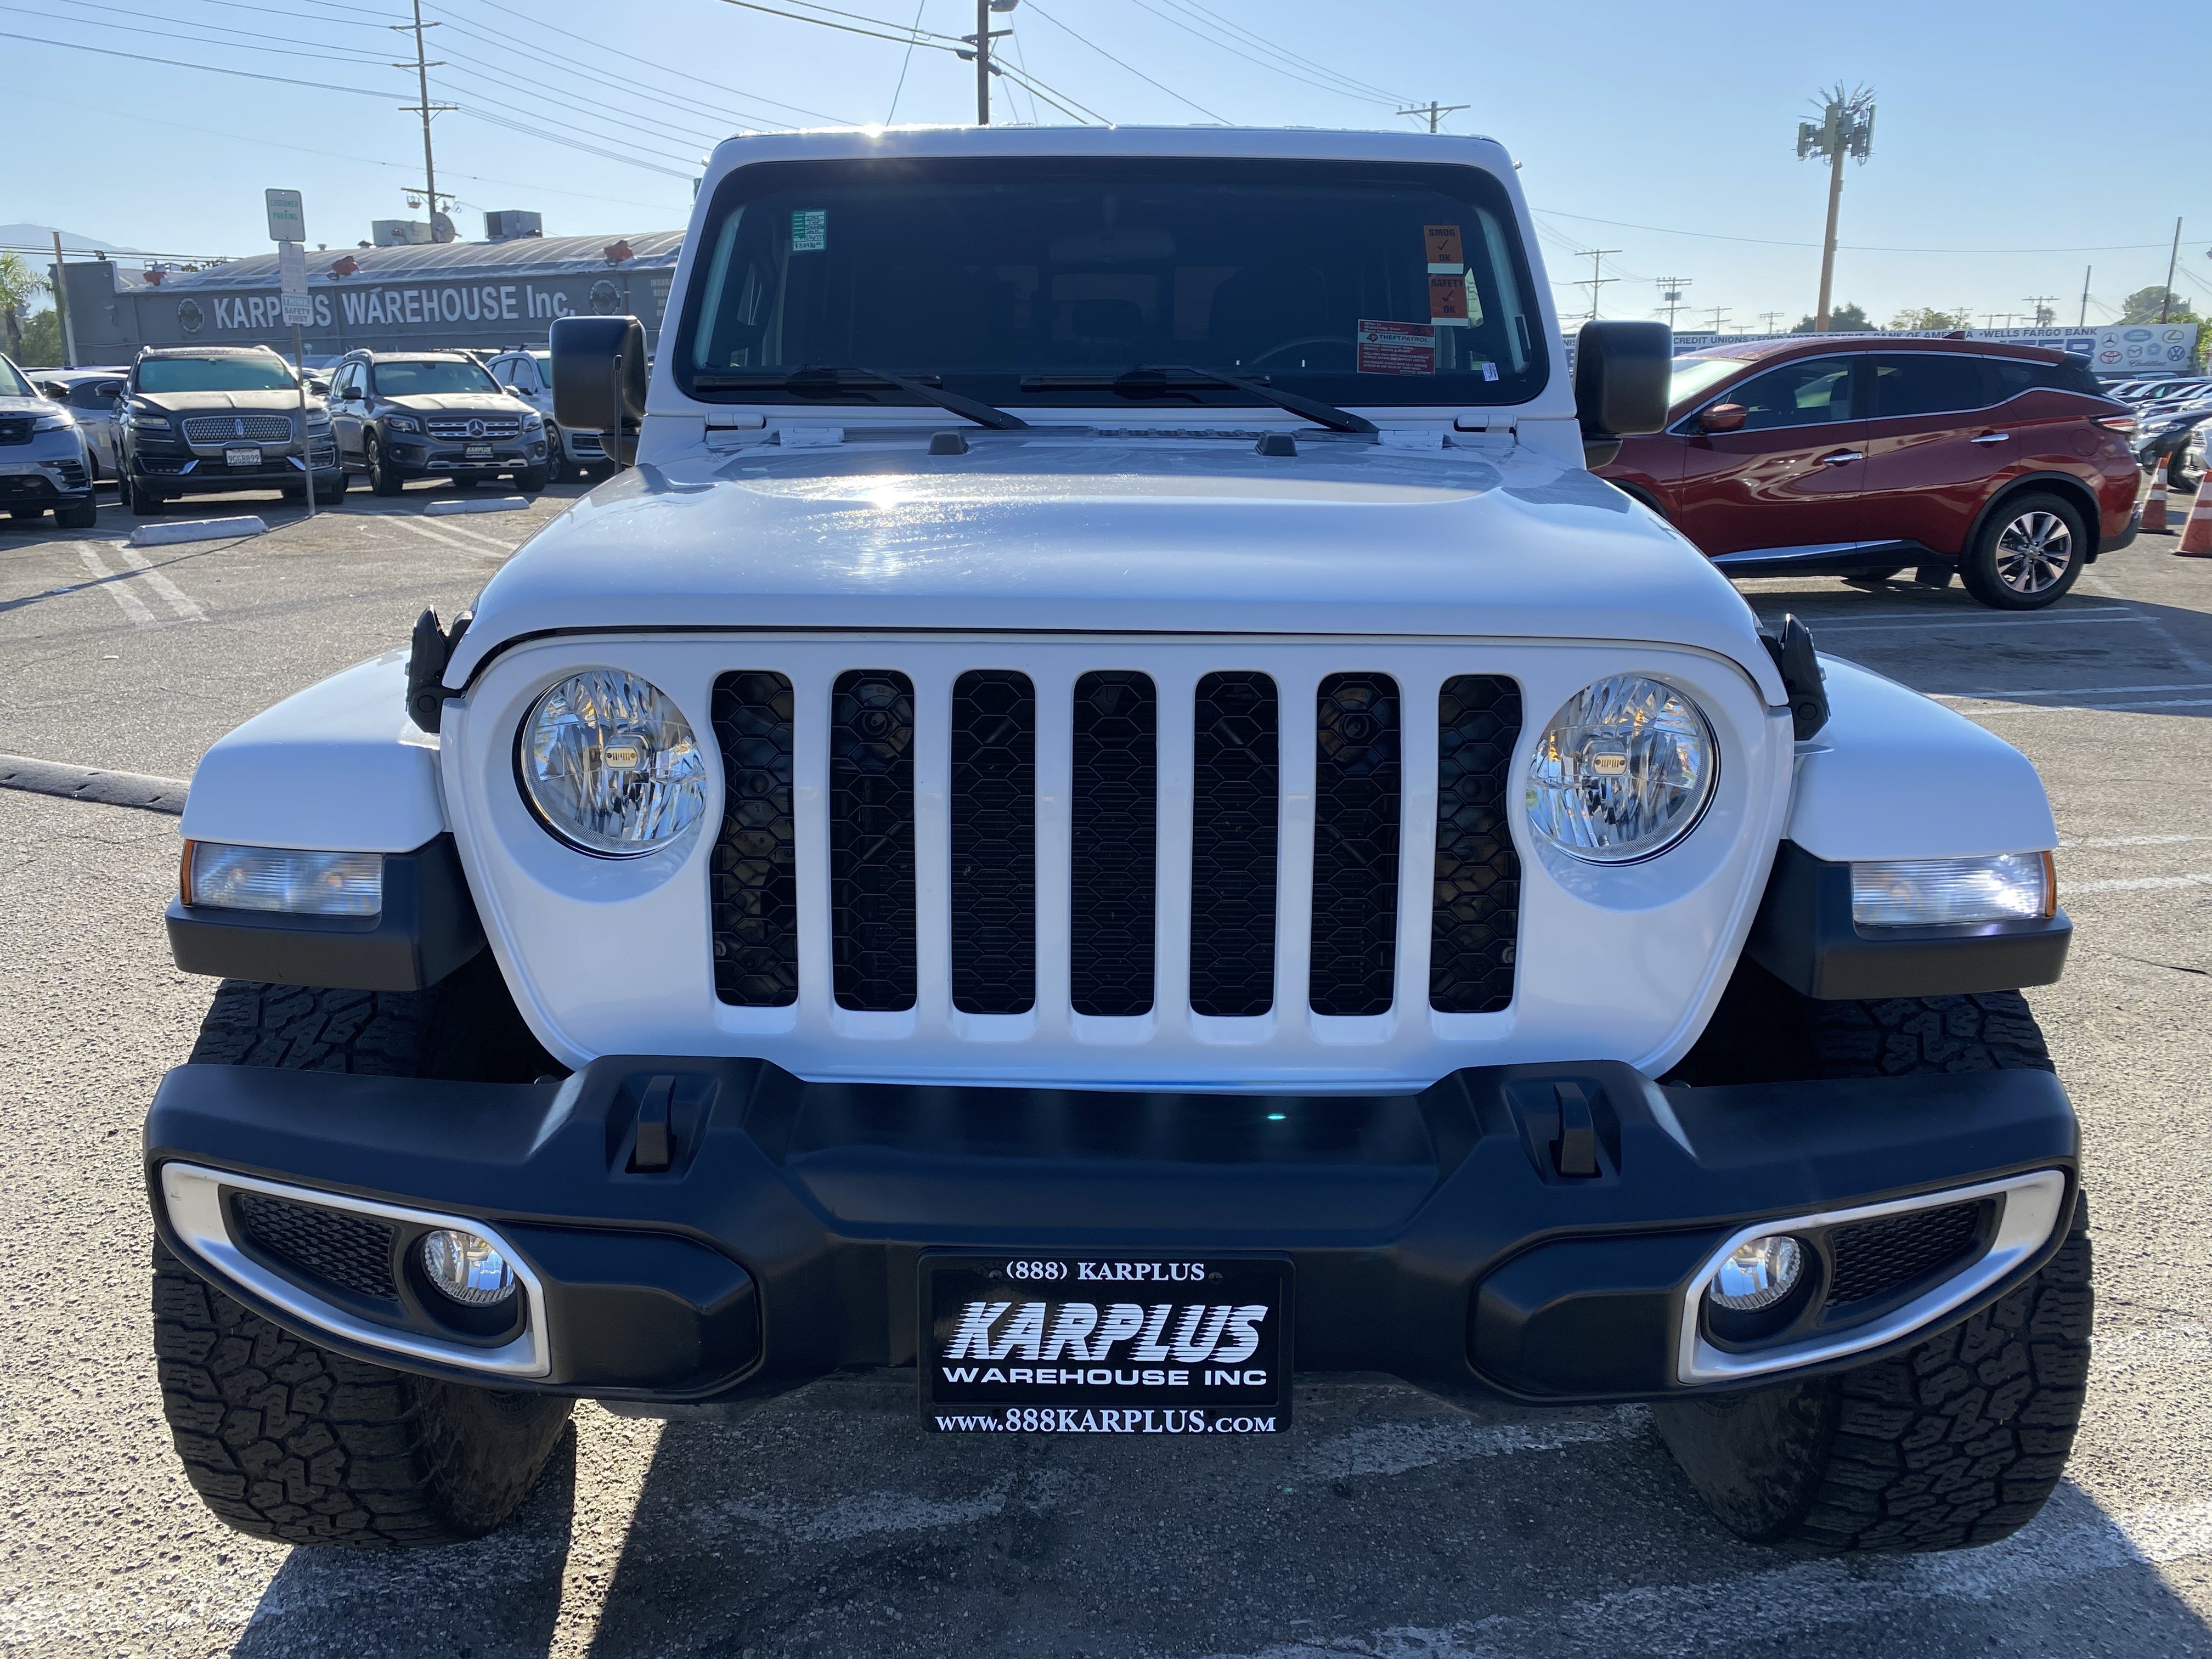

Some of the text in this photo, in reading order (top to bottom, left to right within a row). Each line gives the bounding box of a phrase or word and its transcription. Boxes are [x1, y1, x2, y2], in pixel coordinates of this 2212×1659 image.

[269, 199, 298, 207] CUSTOMER
[1431, 279, 1464, 287] SAFETY
[213, 295, 332, 329] KARPS
[341, 286, 519, 325] WAREHOUSE
[526, 285, 575, 318] Inc.
[283, 297, 309, 306] THINK
[2023, 329, 2061, 337] FARGO
[1006, 1261, 1205, 1280] (888) KARPLUS
[942, 1302, 1268, 1363] KARPLUS
[942, 1367, 1267, 1386] WAREHOUSE INC
